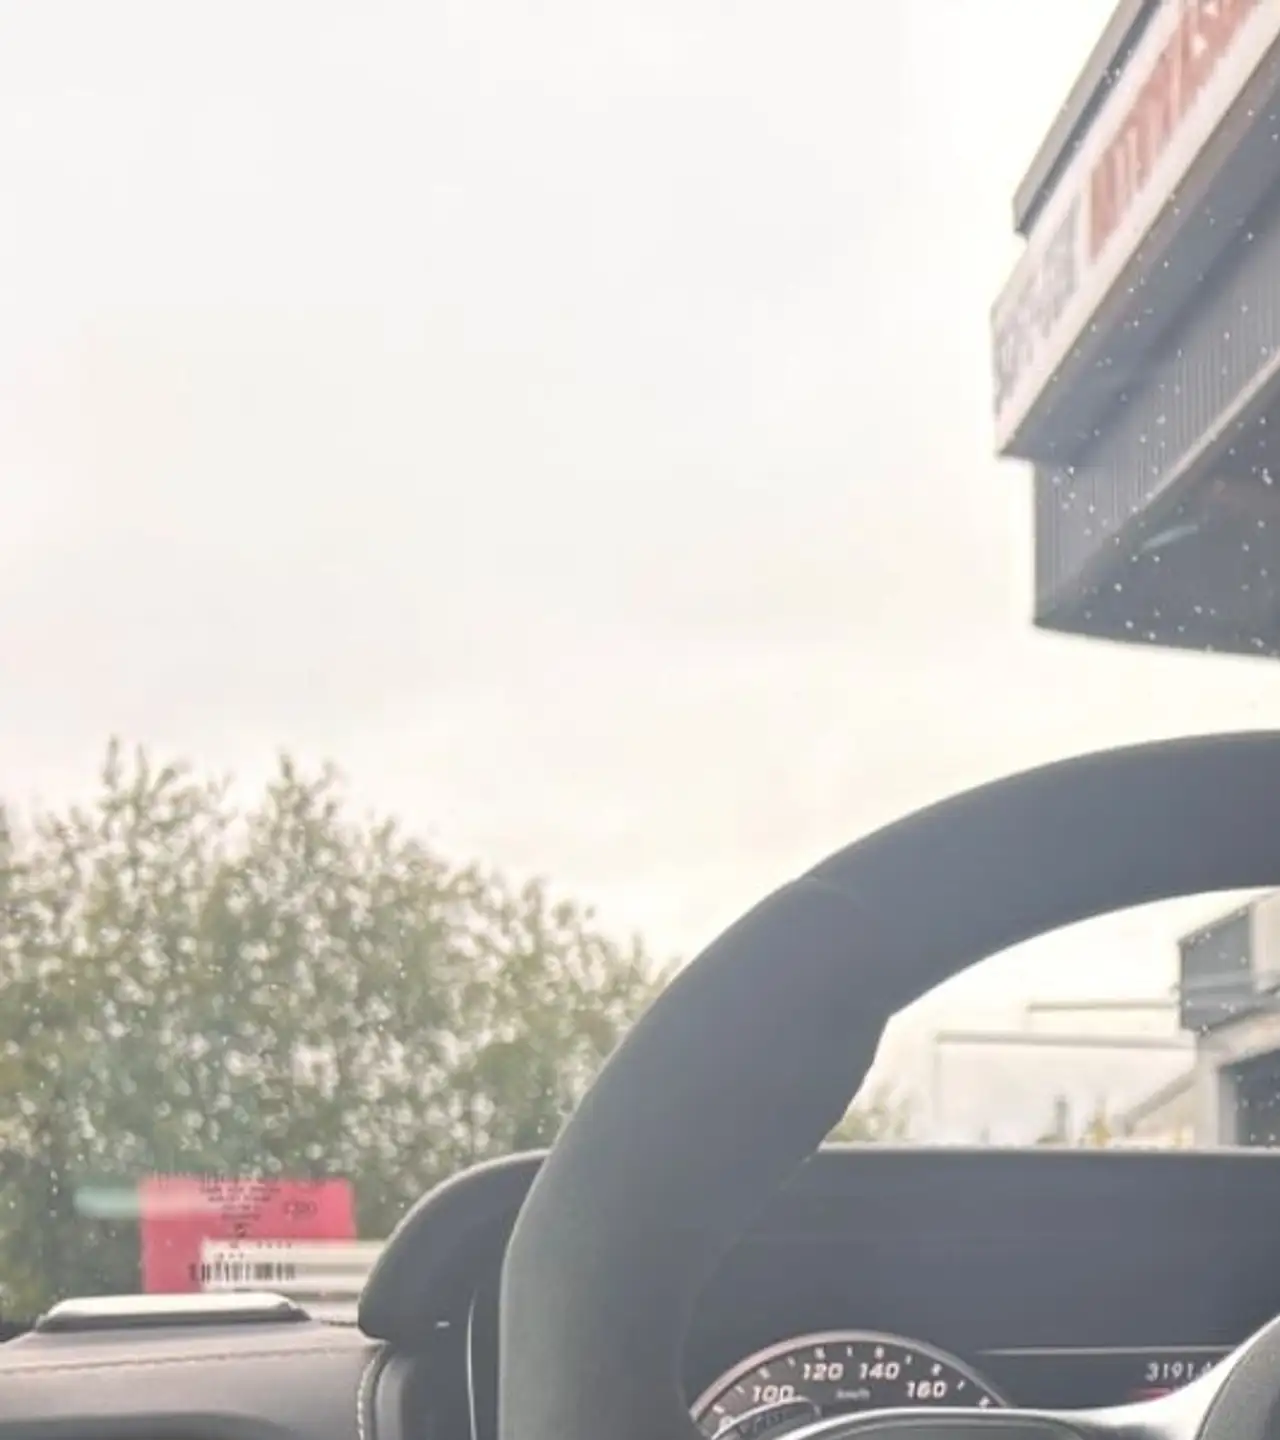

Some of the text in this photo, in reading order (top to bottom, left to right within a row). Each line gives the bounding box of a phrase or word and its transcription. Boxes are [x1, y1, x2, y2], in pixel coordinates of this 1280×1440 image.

[802, 1362, 844, 1381] 120
[859, 1361, 900, 1381] 140
[752, 1384, 794, 1402] 100
[906, 1380, 947, 1399] 160
